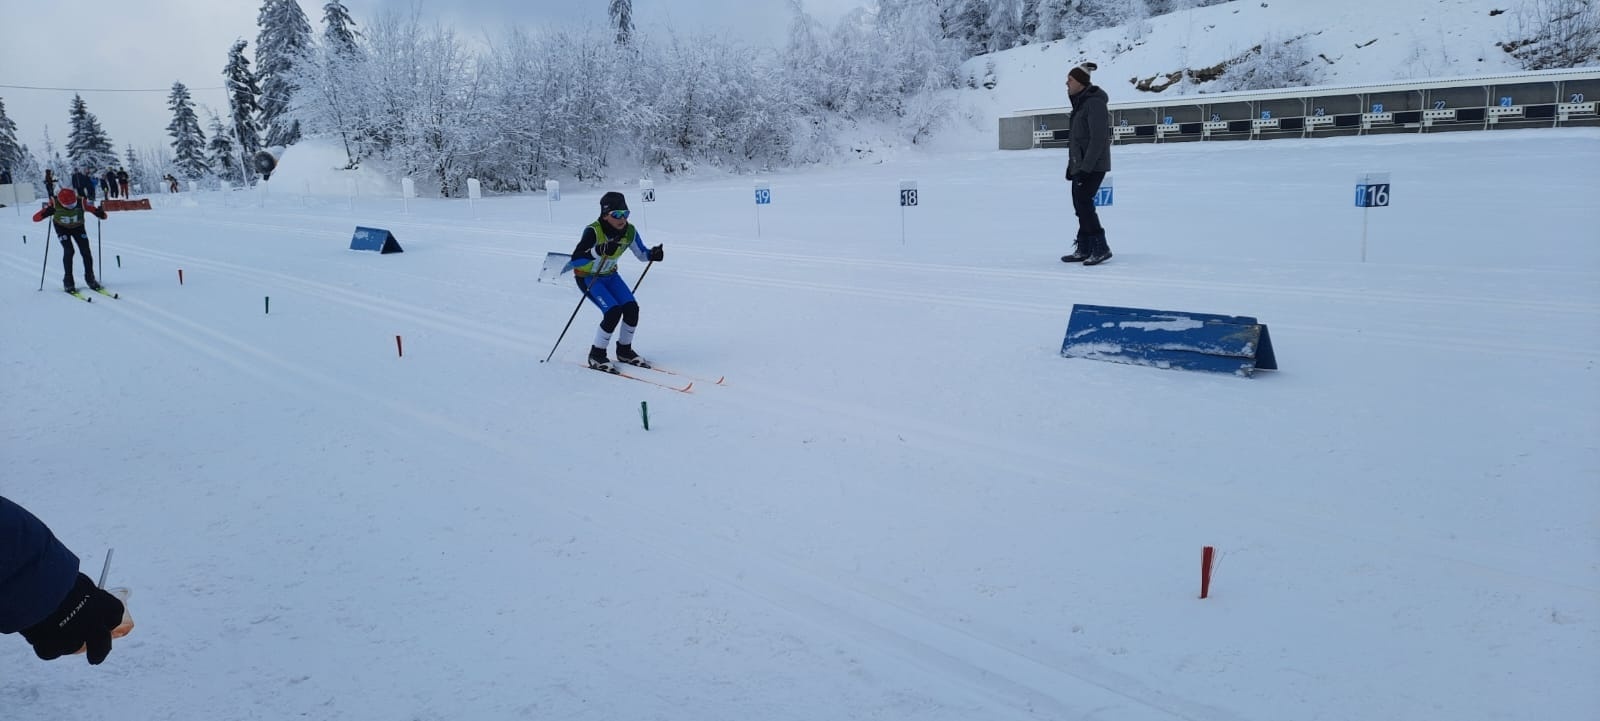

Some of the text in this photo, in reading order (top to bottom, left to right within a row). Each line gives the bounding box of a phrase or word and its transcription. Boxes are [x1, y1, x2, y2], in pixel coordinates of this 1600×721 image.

[1501, 97, 1512, 107] 21
[1571, 93, 1584, 104] 20
[1372, 104, 1384, 113] 23
[1435, 101, 1446, 110] 22
[642, 189, 655, 202] 20
[756, 189, 770, 204] 19
[902, 190, 917, 206] 18
[1098, 188, 1112, 205] 17
[1368, 185, 1389, 206] 16
